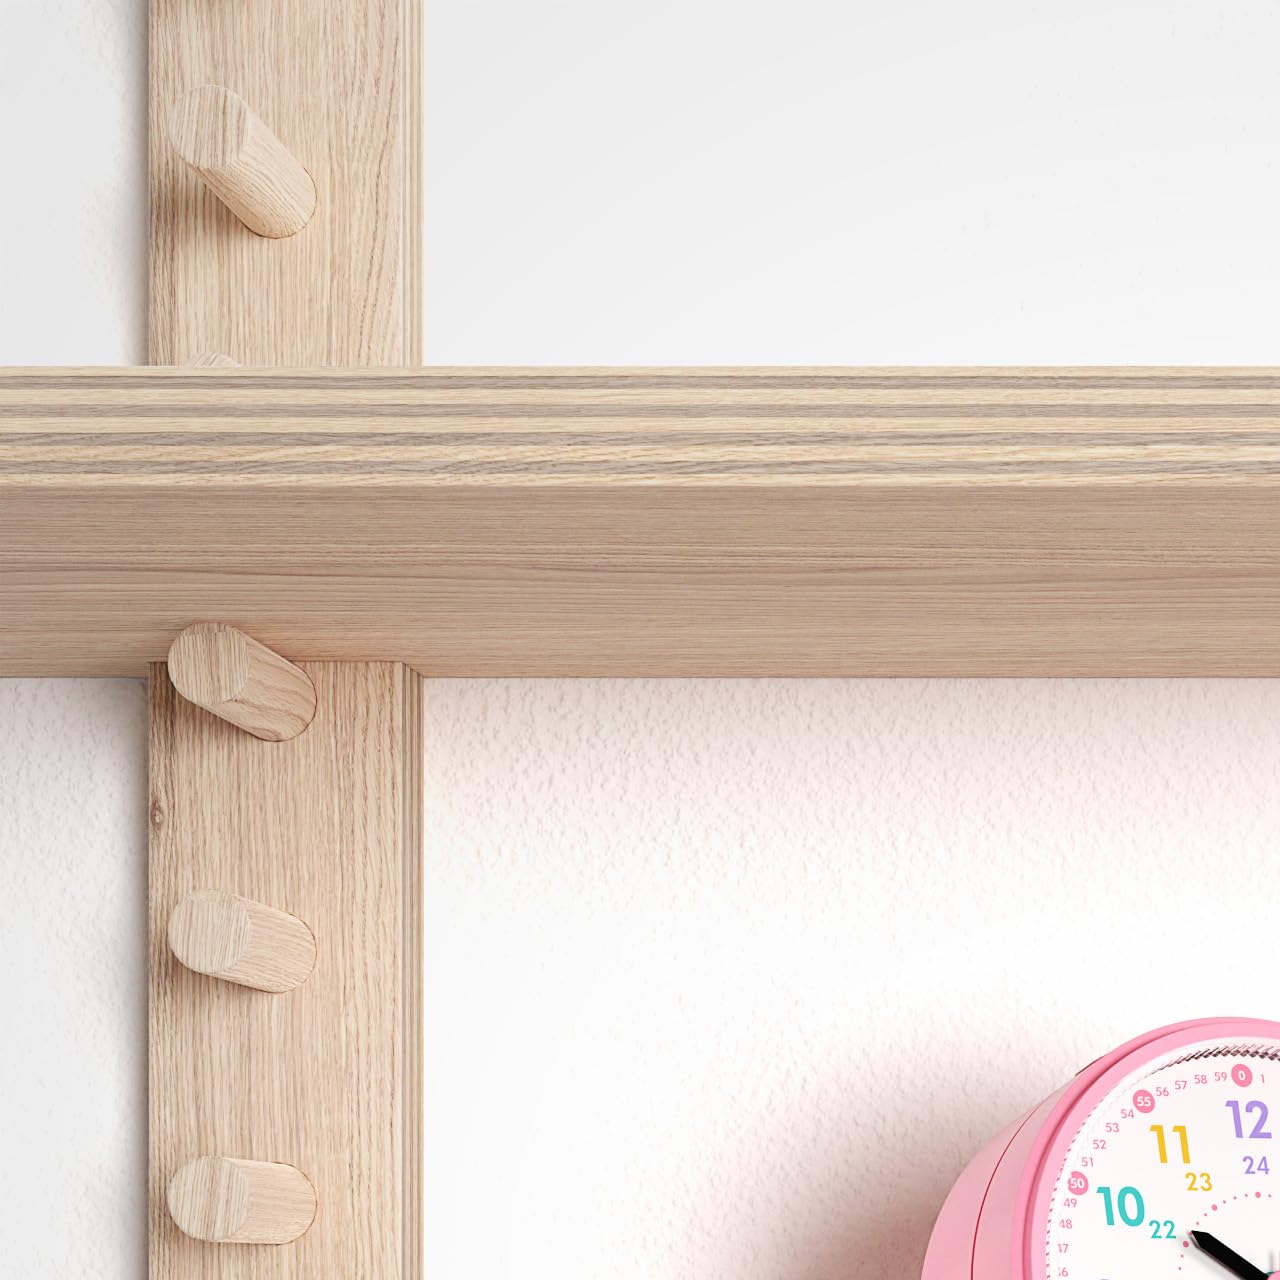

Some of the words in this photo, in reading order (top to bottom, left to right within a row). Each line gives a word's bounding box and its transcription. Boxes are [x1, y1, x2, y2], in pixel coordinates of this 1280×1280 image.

[1194, 1075, 1207, 1085] 58
[1214, 1072, 1227, 1081] 59
[1238, 1071, 1246, 1080] 0
[1175, 1080, 1188, 1090] 57
[1156, 1087, 1169, 1097] 56
[1137, 1096, 1151, 1107] 55
[1121, 1109, 1134, 1118] 54
[1225, 1100, 1272, 1139] 12
[1105, 1123, 1120, 1133] 53
[1093, 1140, 1107, 1149] 52
[1150, 1125, 1190, 1164] 11
[1081, 1157, 1094, 1167] 51
[1243, 1156, 1270, 1175] 24
[1070, 1178, 1085, 1189] 50
[1185, 1172, 1213, 1191] 23
[1064, 1198, 1078, 1208] 49
[1096, 1186, 1145, 1227] 10
[1060, 1219, 1073, 1229] 48
[1149, 1220, 1177, 1239] 22
